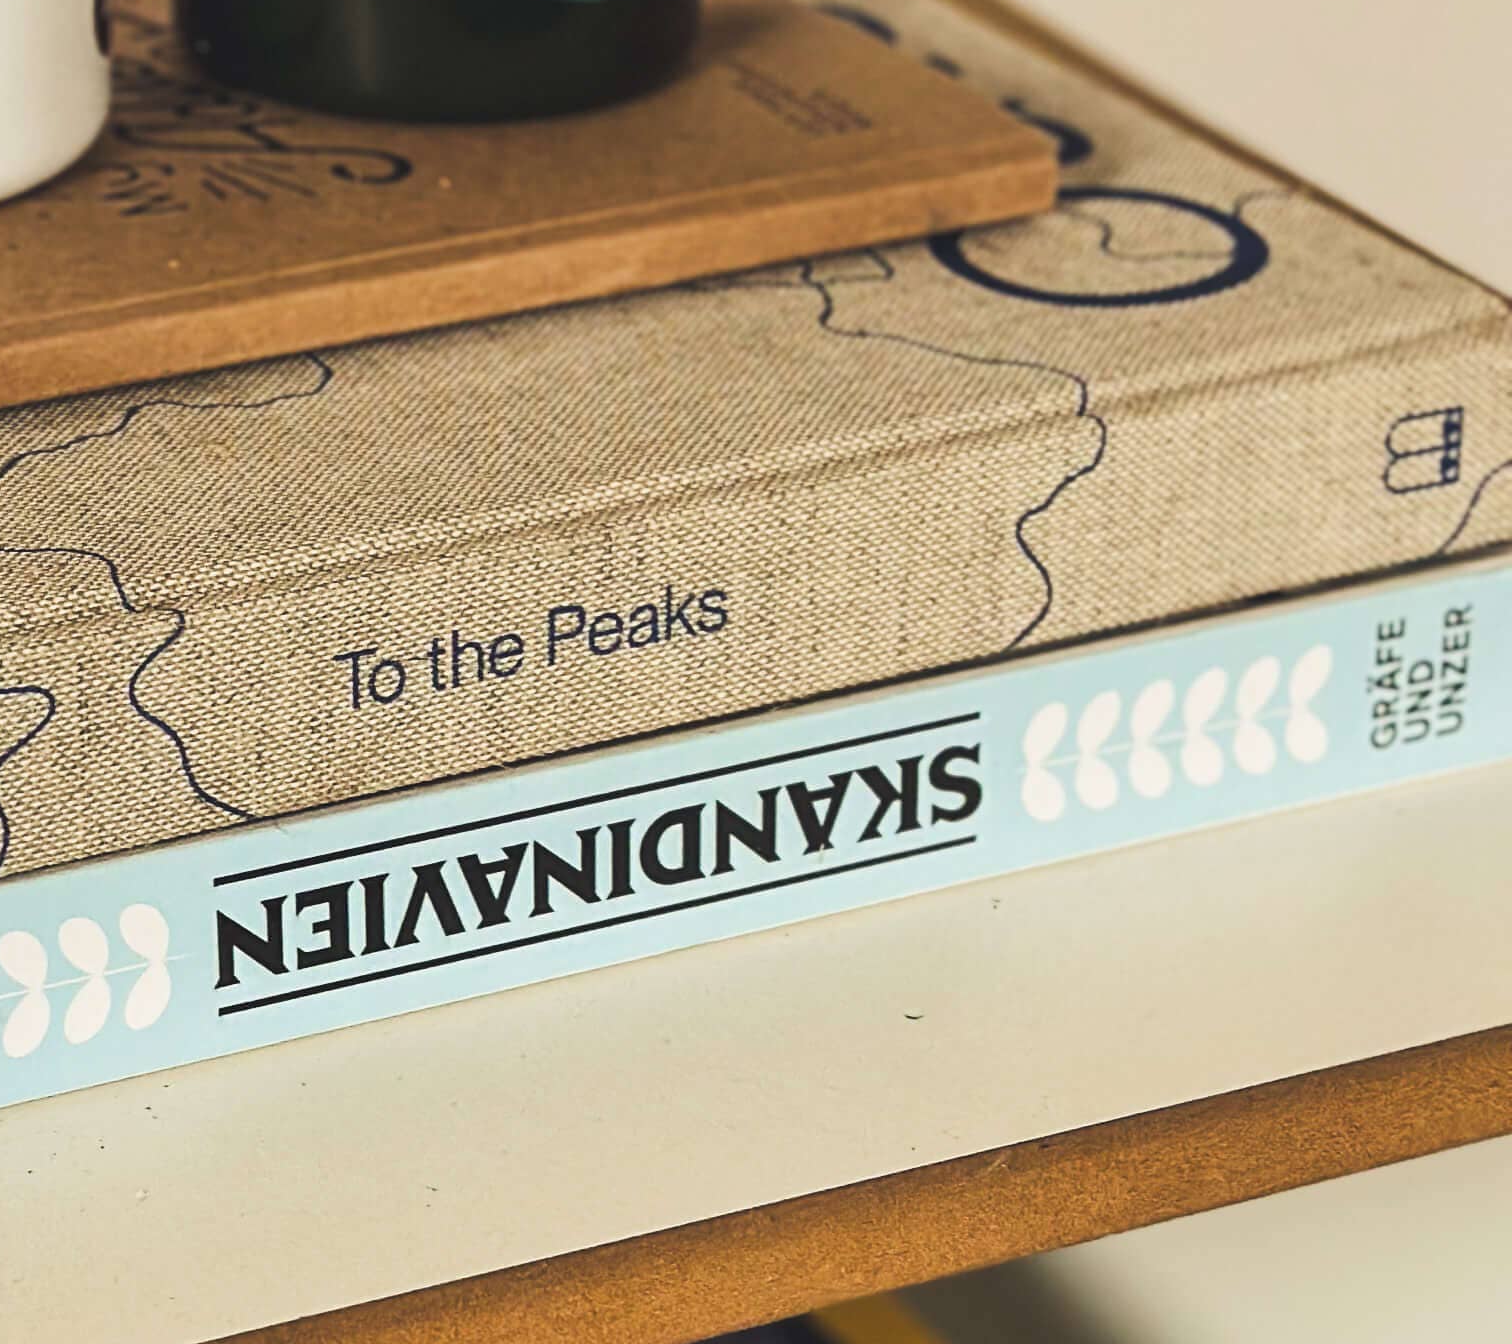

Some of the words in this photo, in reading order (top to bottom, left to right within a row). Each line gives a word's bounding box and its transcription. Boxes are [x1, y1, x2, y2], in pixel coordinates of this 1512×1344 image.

[335, 650, 406, 709] To
[429, 628, 524, 692] the
[547, 585, 730, 666] Peaks
[1366, 616, 1406, 750] GRÄFE
[1402, 659, 1435, 744] UND
[1436, 603, 1473, 737] UNZER
[214, 742, 984, 990] SKANDINAVIEN
